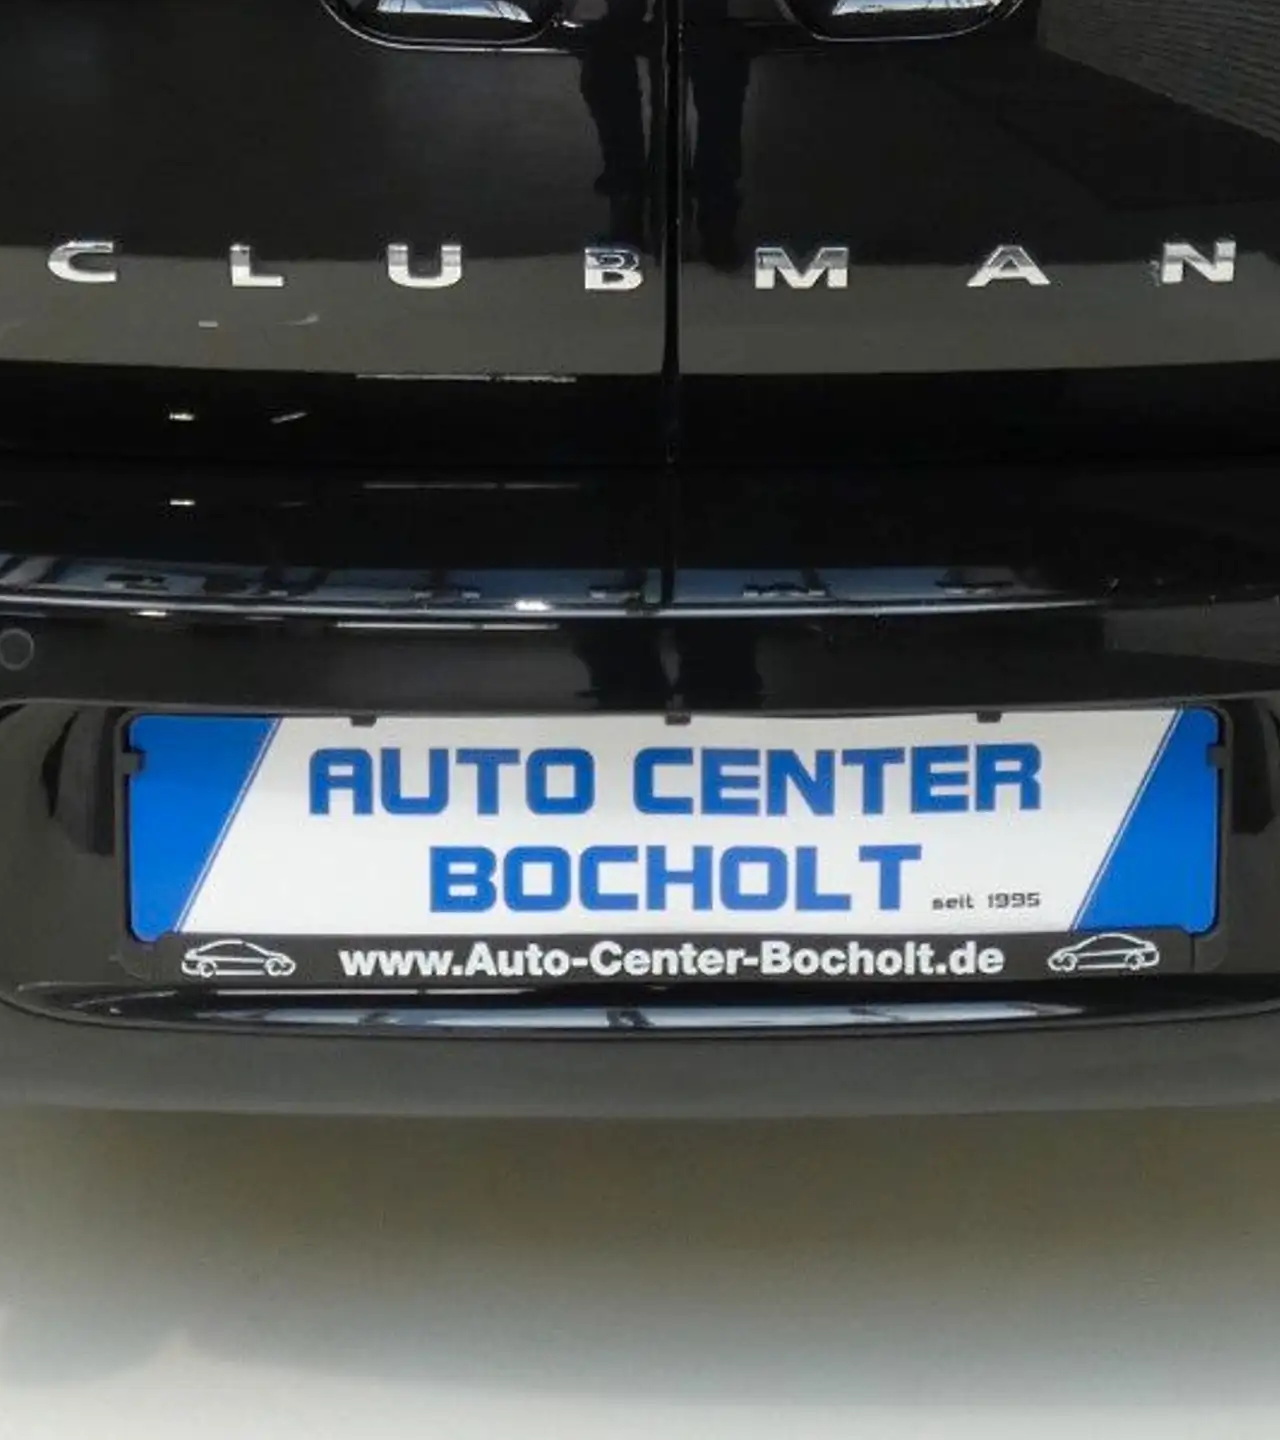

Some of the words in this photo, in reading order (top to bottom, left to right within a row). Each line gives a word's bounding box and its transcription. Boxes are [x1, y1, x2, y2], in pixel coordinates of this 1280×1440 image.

[46, 240, 1239, 291] CLUBMAN
[309, 746, 598, 817] AUTO
[632, 743, 1042, 818] CENTER
[429, 843, 921, 914] BOCHOLT
[931, 892, 975, 910] seit
[987, 891, 1041, 909] 1995
[338, 939, 1006, 980] www.Auto-Center-Bocholt.de
